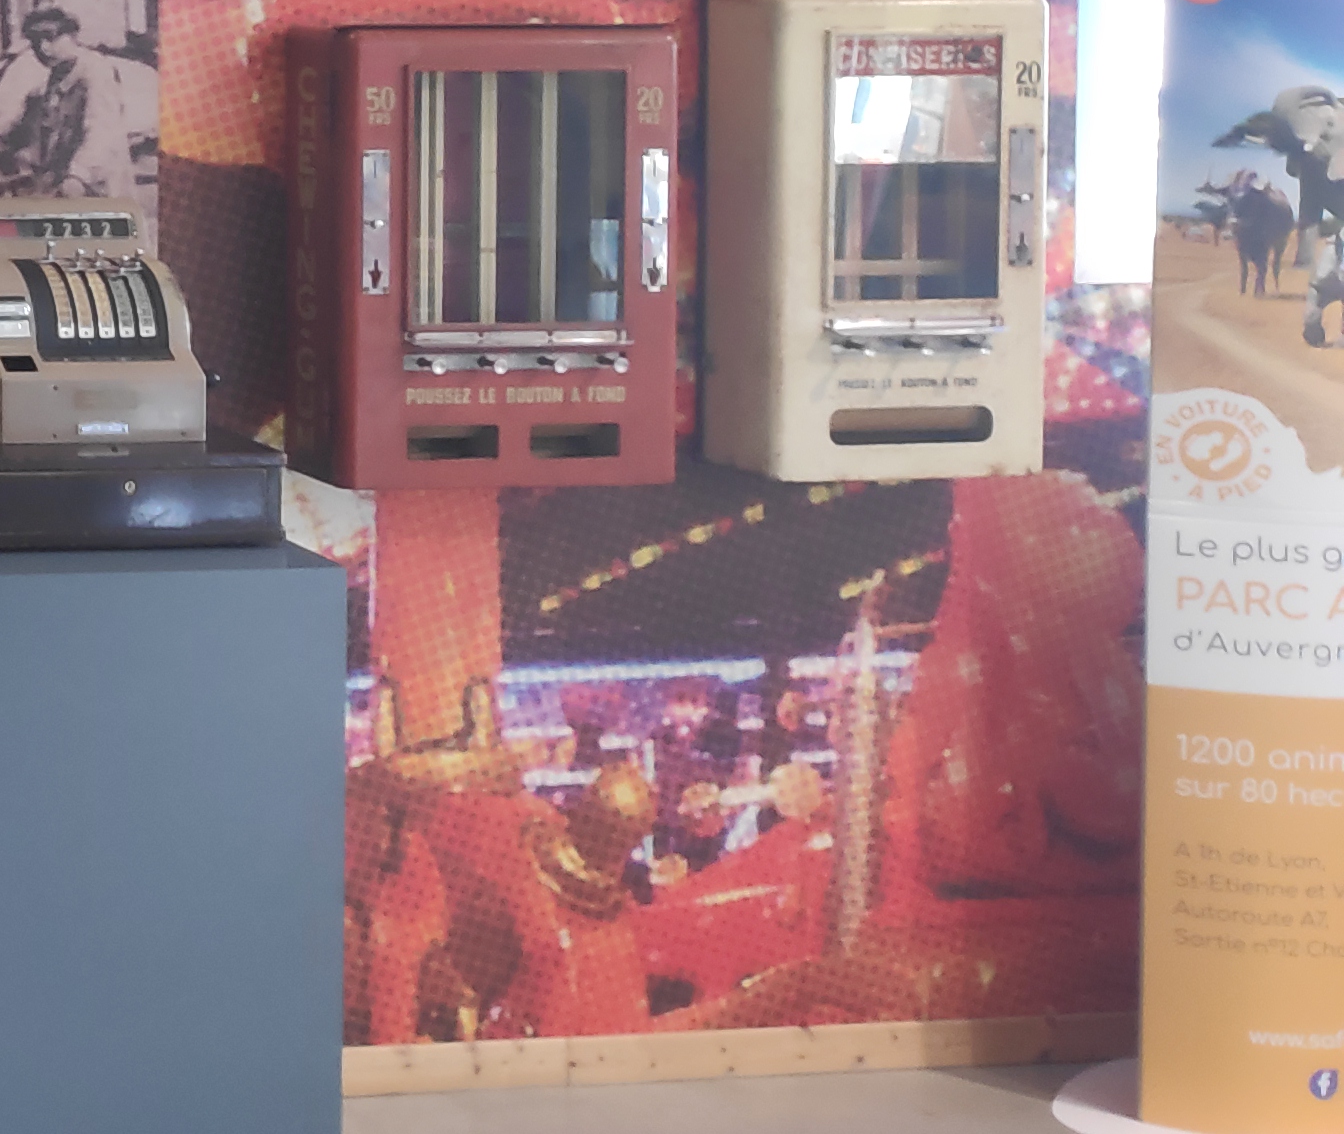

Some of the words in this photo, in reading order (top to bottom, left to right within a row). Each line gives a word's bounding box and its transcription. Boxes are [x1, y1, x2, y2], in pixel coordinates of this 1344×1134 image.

[1015, 61, 1042, 85] 20
[365, 86, 396, 112] 50
[636, 86, 664, 112] 20
[1164, 399, 1269, 439] VOITURE
[1175, 530, 1218, 559] Le
[1231, 535, 1310, 566] plus
[1176, 575, 1310, 620] PARC
[1175, 732, 1256, 768] 1200
[1174, 777, 1231, 800] sur
[1241, 777, 1278, 804] 80
[1174, 926, 1247, 952] Sortie
